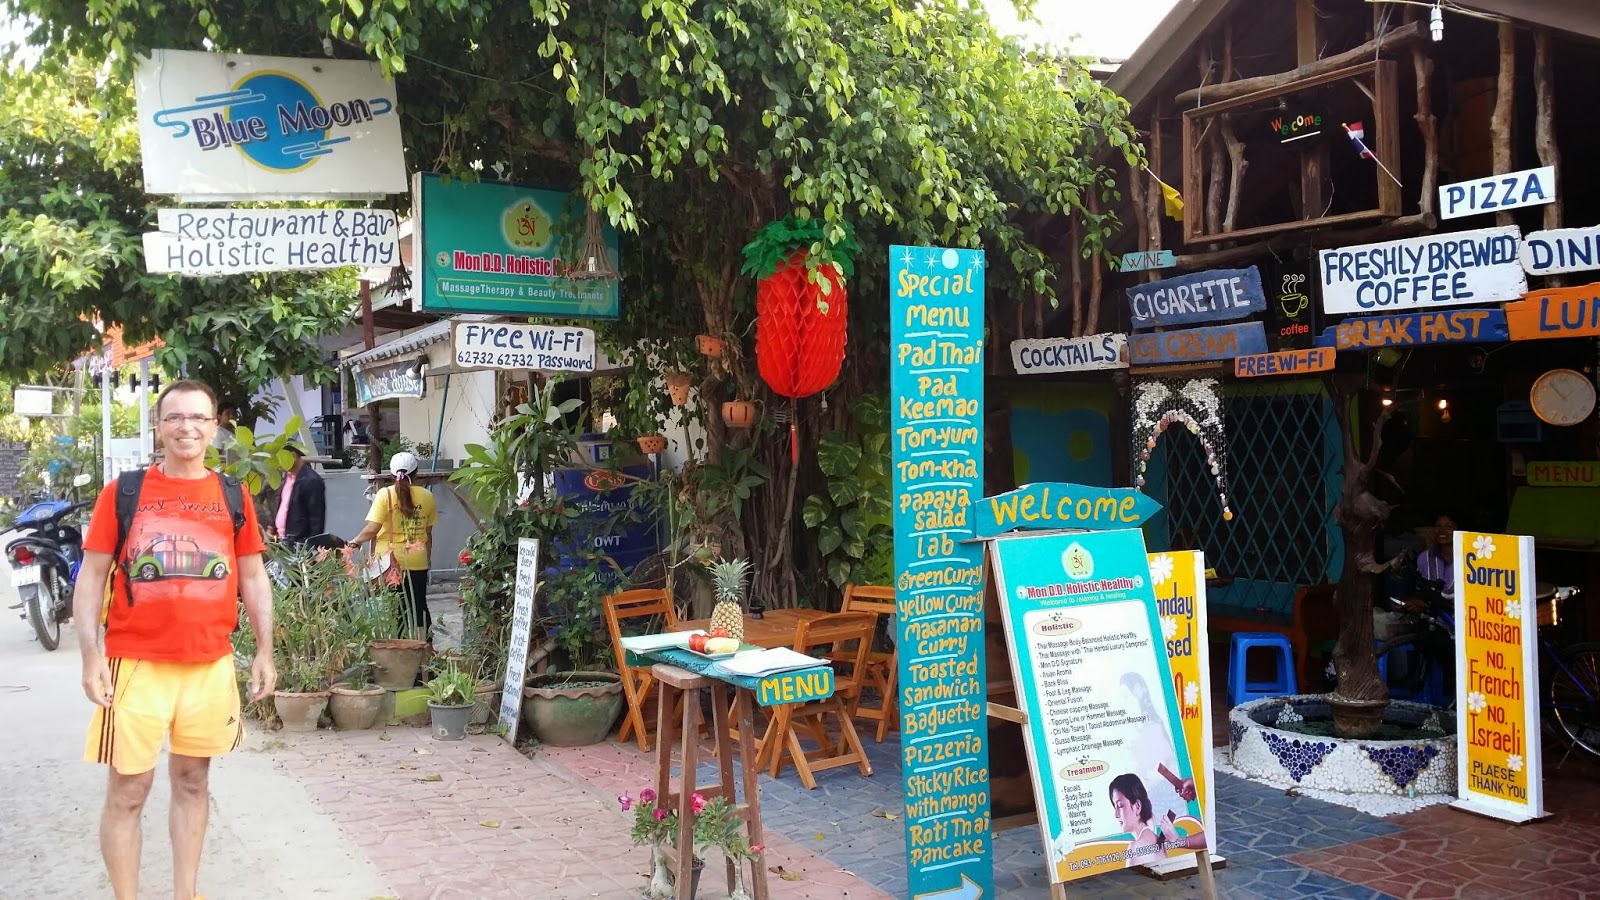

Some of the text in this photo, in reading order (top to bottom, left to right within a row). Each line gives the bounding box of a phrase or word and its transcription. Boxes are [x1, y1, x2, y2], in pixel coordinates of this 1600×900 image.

[192, 98, 373, 151] Blue Moon
[1447, 173, 1545, 213] PIZZA
[168, 237, 394, 268] Holistic Healthy
[454, 251, 481, 271] Mon
[506, 255, 551, 276] Holistic
[1125, 252, 1164, 269] WINE
[1324, 235, 1516, 285] FRESHLY BREWED
[1528, 234, 1600, 269] DIN
[528, 287, 553, 299] Beauty
[898, 269, 973, 298] Special
[1357, 272, 1473, 308] COFFEE
[1133, 277, 1250, 320] CIGARETTE
[906, 305, 970, 327] Menu
[466, 326, 584, 352] Free Wi-Fi
[1281, 324, 1309, 336] coffee
[1336, 311, 1489, 349] BREAK FAST
[898, 339, 936, 366] Pad
[1020, 338, 1116, 368] COCKTAILS
[1132, 331, 1238, 358] ICE CREAM
[458, 352, 593, 370] 62732 62732 Password
[1238, 351, 1323, 375] FREE WI-FI
[918, 375, 957, 396] Pad
[1534, 466, 1594, 482] MENU
[991, 488, 1140, 526] Welcome
[1466, 552, 1516, 596] Sorry
[1027, 586, 1047, 599] Mon
[1066, 581, 1100, 595] Holistic
[1101, 577, 1134, 591] Healthy
[1041, 597, 1067, 606] Welcome
[1041, 622, 1074, 632] Holistic
[1469, 606, 1521, 645] Russian
[1048, 640, 1068, 649] Massage
[1049, 649, 1070, 658] Massage
[908, 648, 978, 683] Toasted
[762, 672, 829, 703] MENU
[904, 678, 980, 706] Sandwich
[1062, 688, 1071, 696] Leg
[1071, 685, 1092, 694] Massage
[1470, 659, 1520, 700] French
[1067, 696, 1083, 704] Fusion
[1186, 707, 1199, 719] PM
[904, 701, 980, 734] Baguette
[1071, 734, 1091, 742] Massage
[1470, 713, 1521, 755] Israeli
[905, 735, 982, 766] Pizzeria
[1081, 743, 1102, 752] Drainage
[1067, 765, 1104, 777] Treatment
[1473, 761, 1515, 782] PLAESE
[1471, 775, 1504, 795] THANK
[910, 811, 990, 846] Roti Thai
[1070, 818, 1092, 827] Manicure
